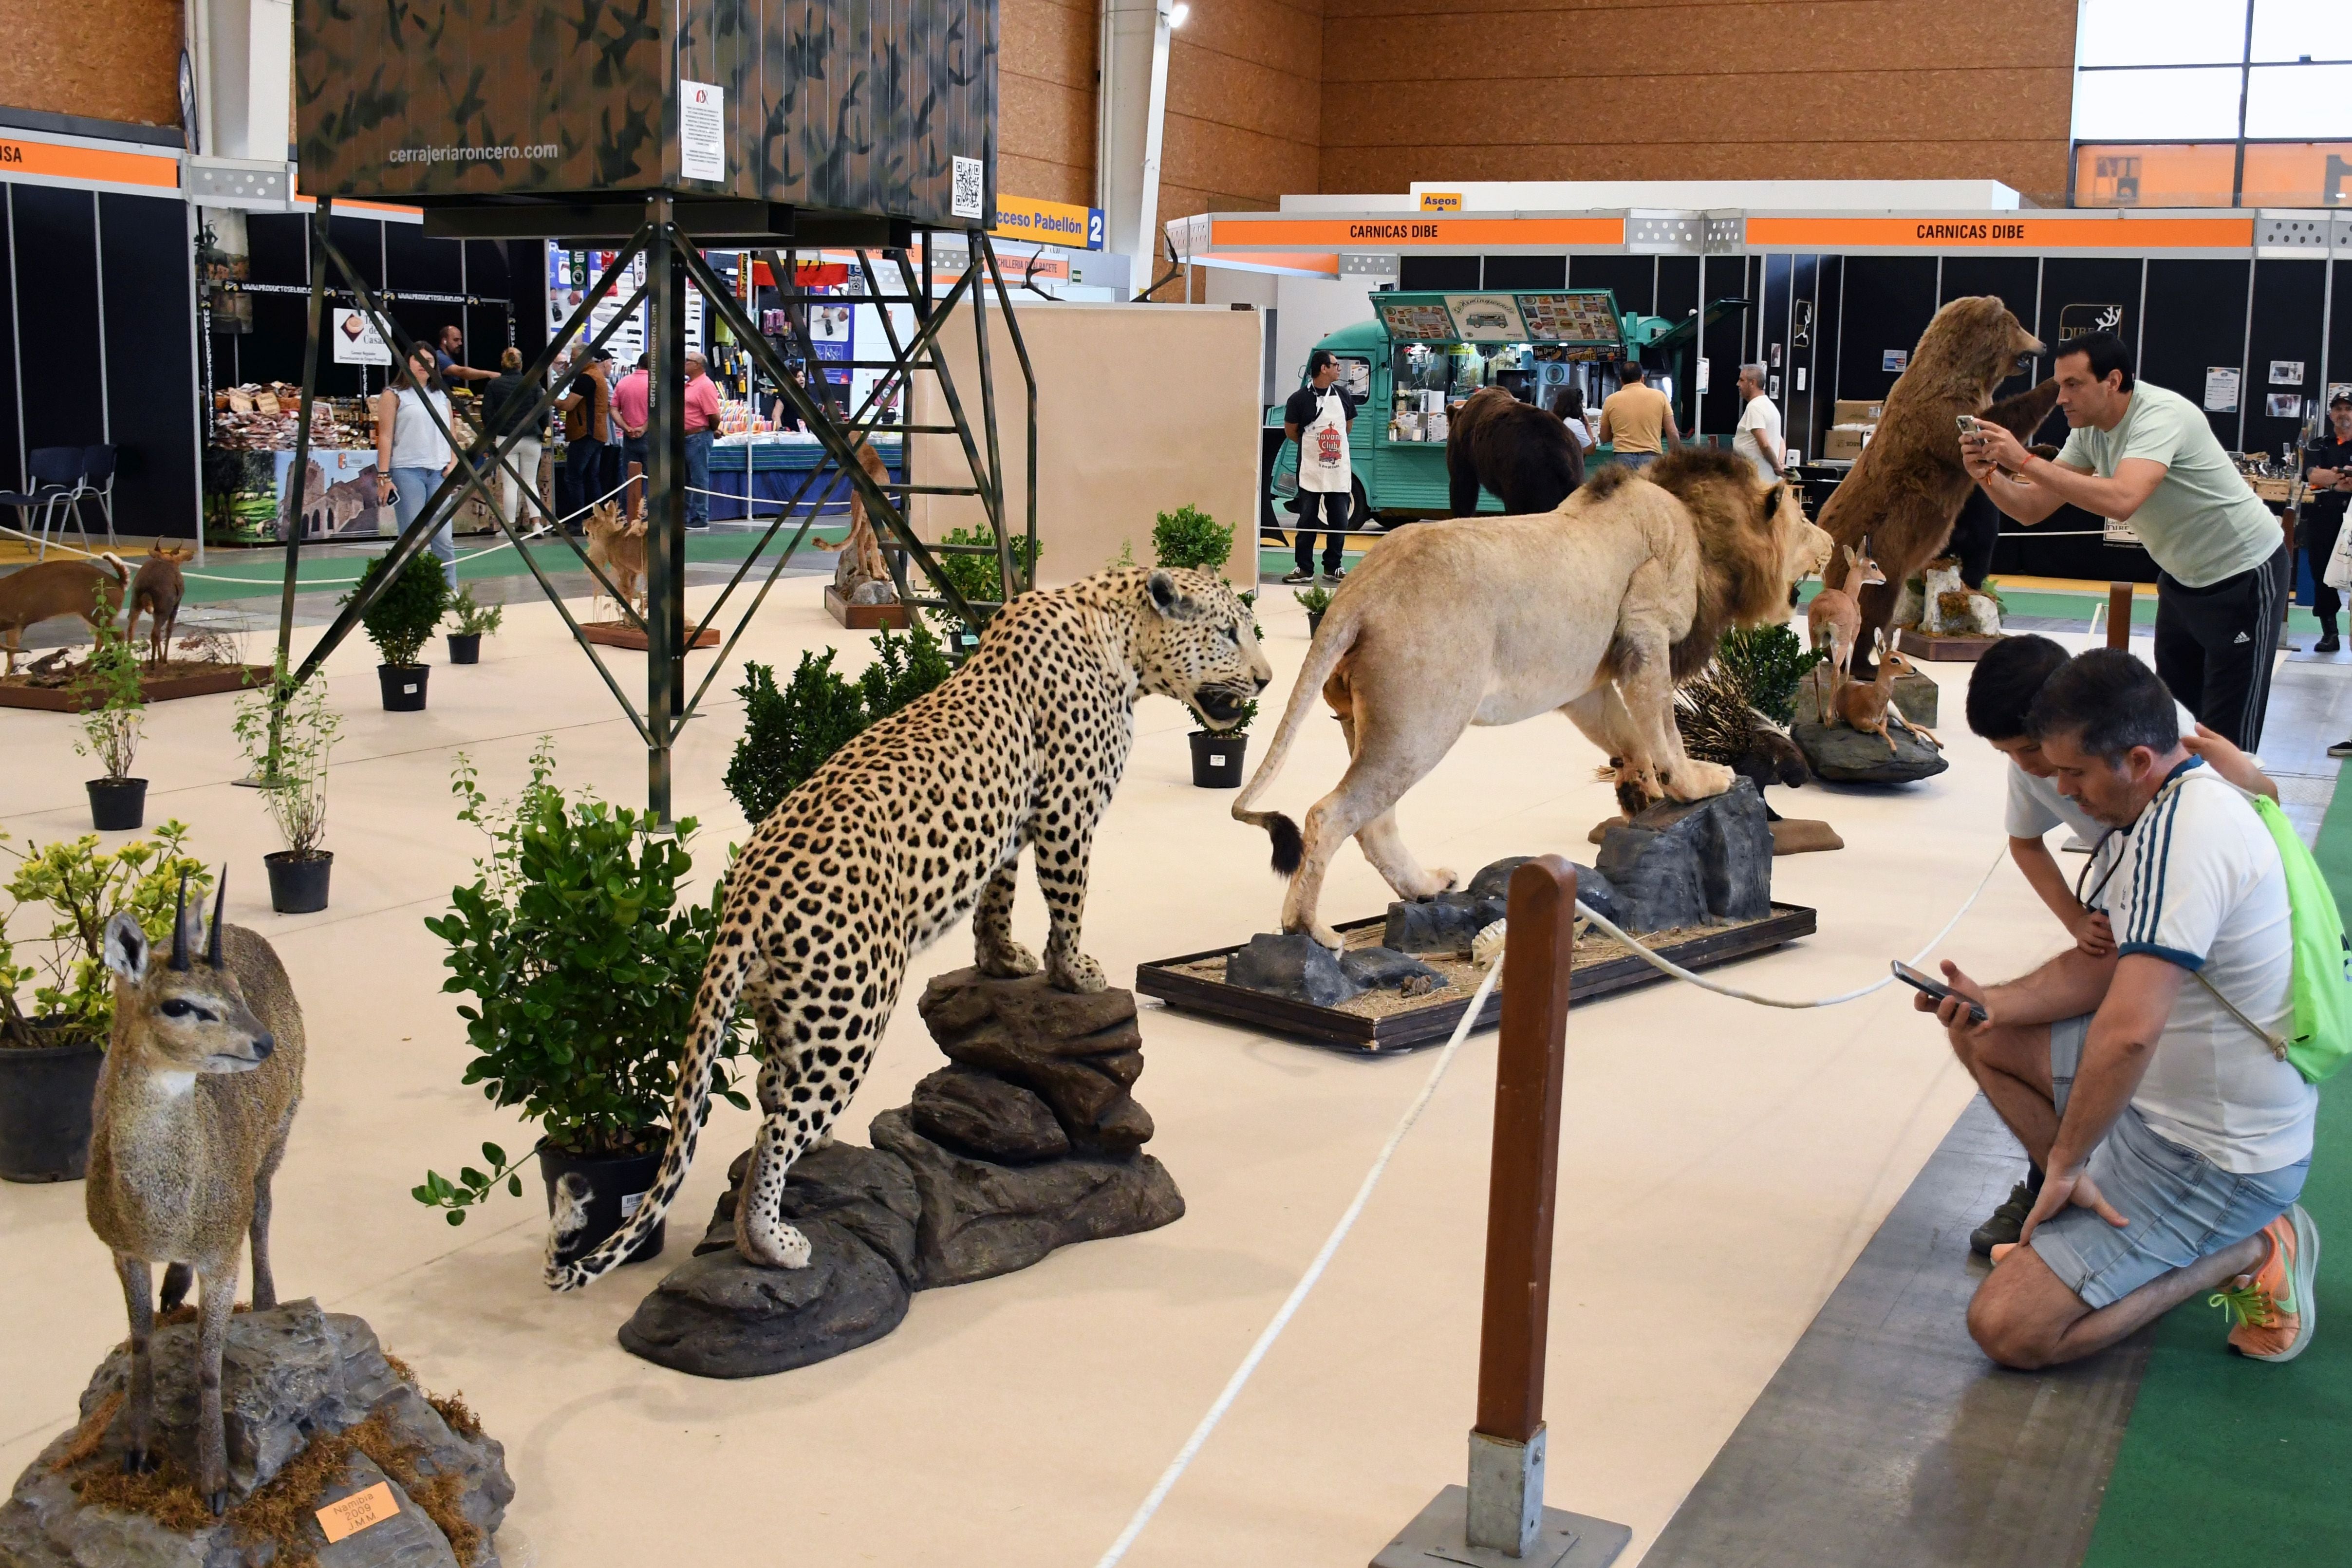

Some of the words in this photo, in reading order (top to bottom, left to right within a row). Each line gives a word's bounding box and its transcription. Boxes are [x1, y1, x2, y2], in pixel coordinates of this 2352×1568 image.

[0, 146, 22, 163] SA
[390, 142, 558, 166] cerrajeriaroncero.com
[1424, 196, 1457, 205] Aseos
[997, 211, 1030, 227] cceso
[1034, 212, 1082, 234] Pabellón
[1090, 216, 1102, 242] 2
[1350, 225, 1407, 238] CARNICAS
[1412, 225, 1438, 238] DIBE
[1917, 225, 1987, 239] CARNICAS
[1993, 225, 2024, 239] DIBE
[998, 258, 1023, 269] CHILLERIA
[333, 1493, 374, 1514] Namibia
[345, 1503, 372, 1521] 2009
[349, 1512, 379, 1531] J.M.M.
